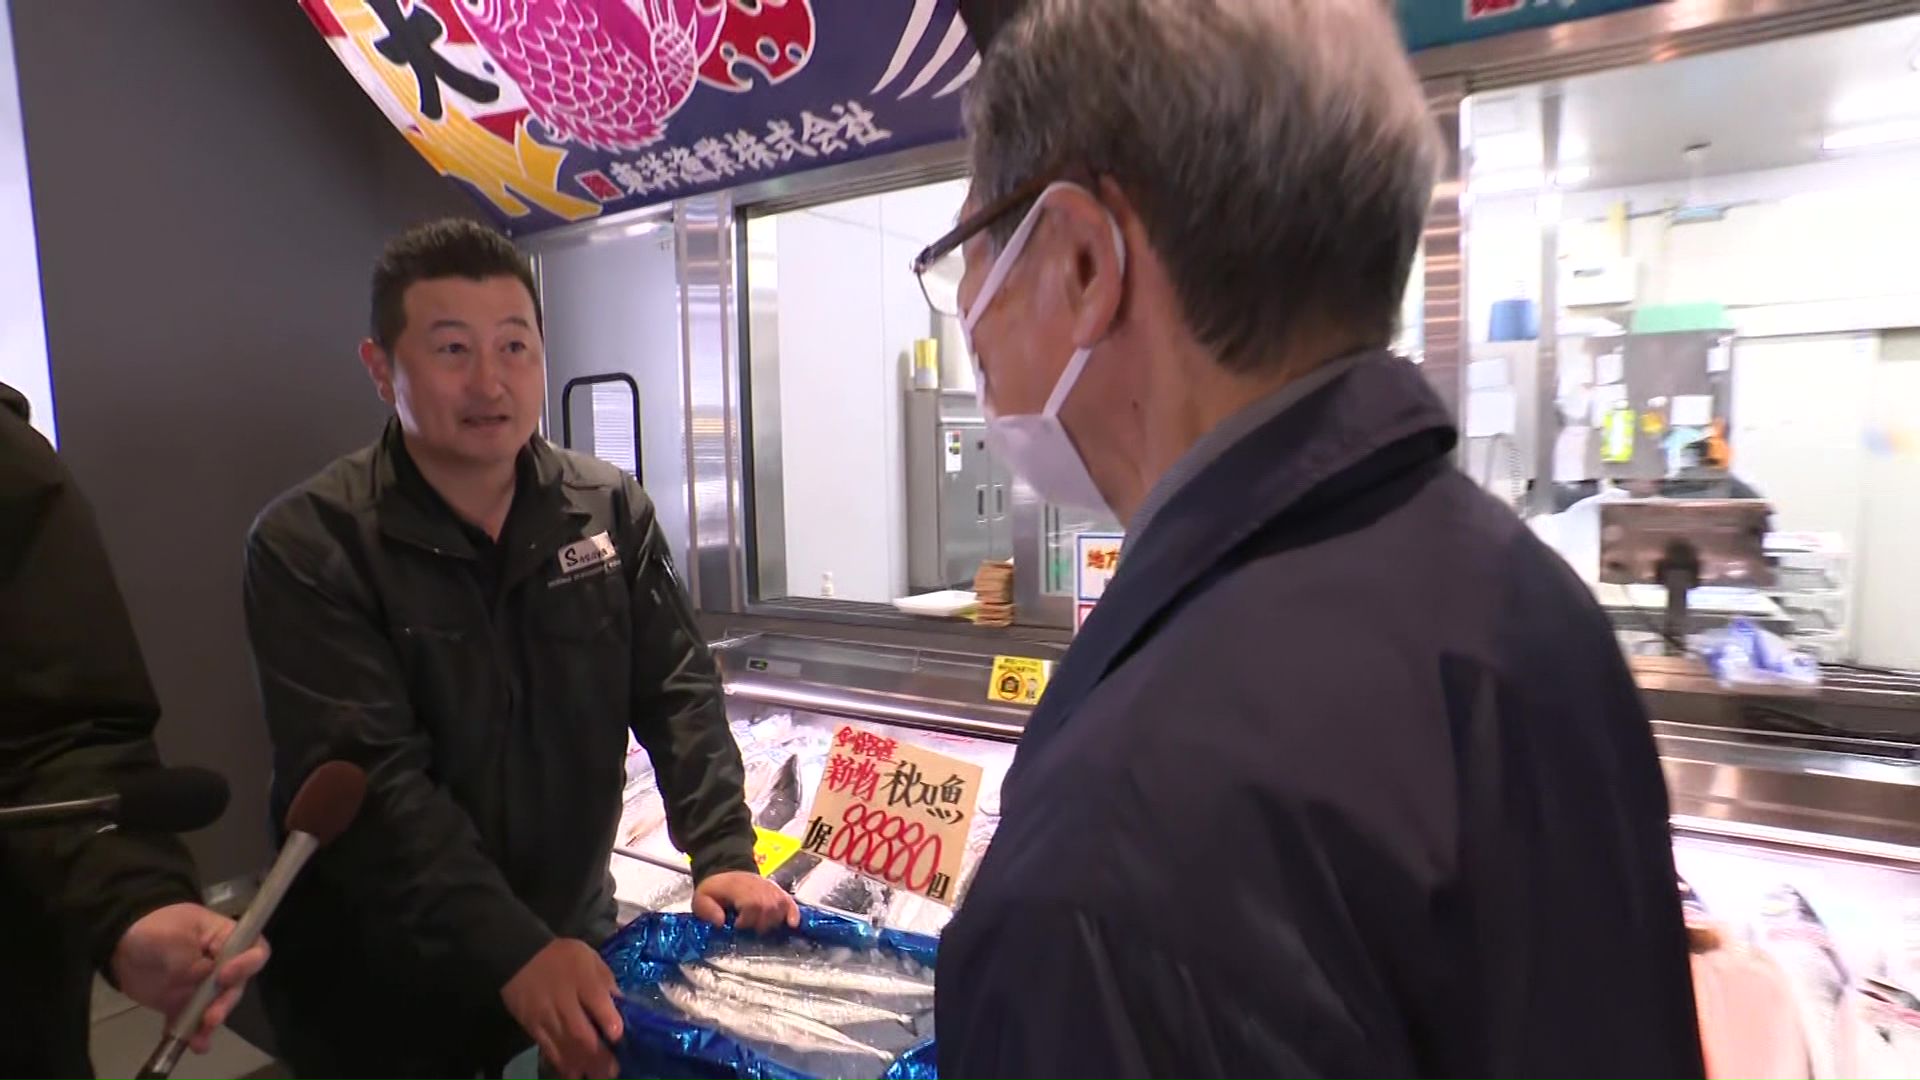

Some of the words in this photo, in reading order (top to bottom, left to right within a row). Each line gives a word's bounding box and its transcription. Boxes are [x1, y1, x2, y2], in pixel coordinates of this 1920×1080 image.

[610, 102, 892, 196] 東洋漁業株式会社
[826, 754, 880, 803] 新物
[880, 760, 966, 825] 秋刀魚
